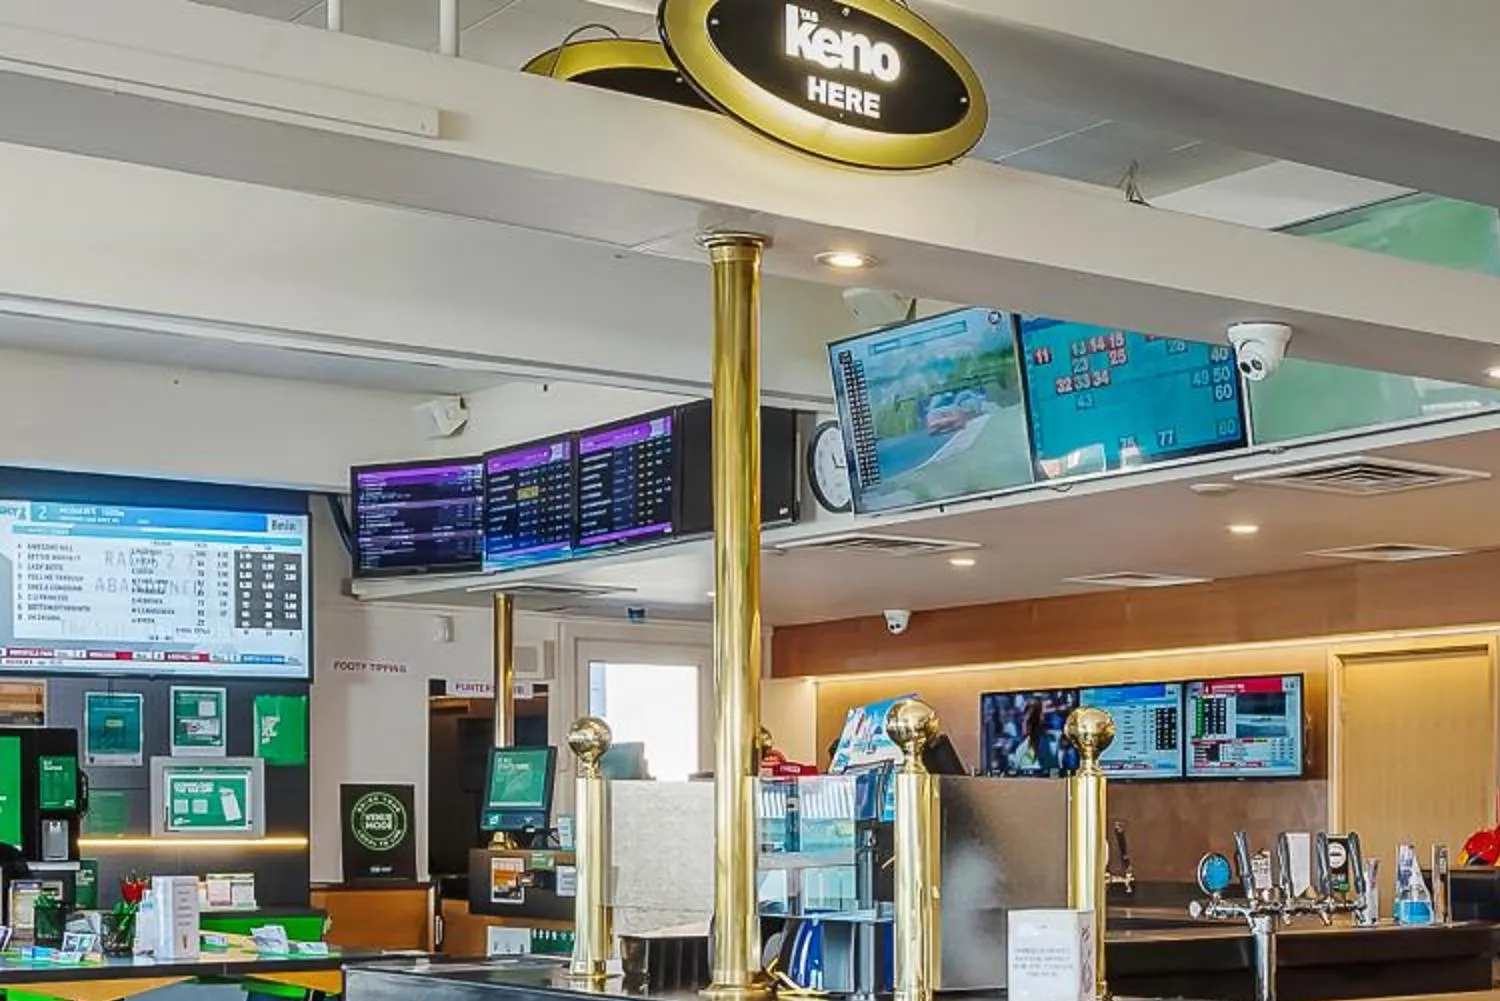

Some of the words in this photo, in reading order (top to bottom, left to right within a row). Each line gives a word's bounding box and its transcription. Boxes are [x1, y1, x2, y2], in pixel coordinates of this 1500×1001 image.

[807, 75, 881, 119] HERE
[1211, 347, 1229, 362] 40
[1193, 369, 1210, 386] 49
[1213, 366, 1231, 382] 50
[1056, 377, 1073, 393] 32
[1215, 383, 1233, 400] 60
[1158, 429, 1175, 446] 77
[38, 505, 48, 520] 2
